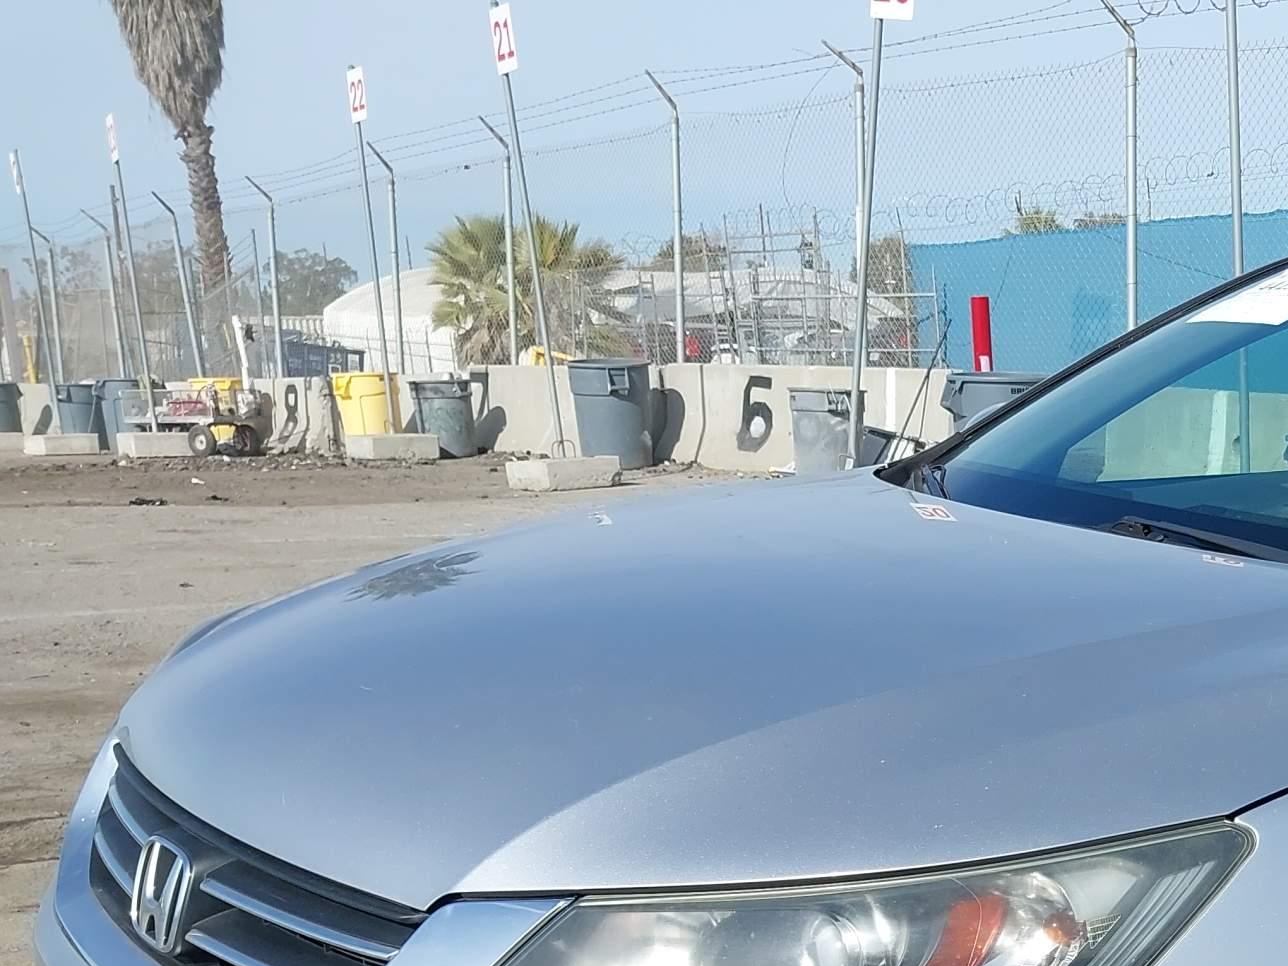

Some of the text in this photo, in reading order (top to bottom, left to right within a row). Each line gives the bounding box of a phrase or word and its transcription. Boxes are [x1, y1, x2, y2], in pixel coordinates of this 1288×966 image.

[493, 18, 515, 62] 21
[349, 79, 366, 113] 22
[736, 375, 774, 453] 6
